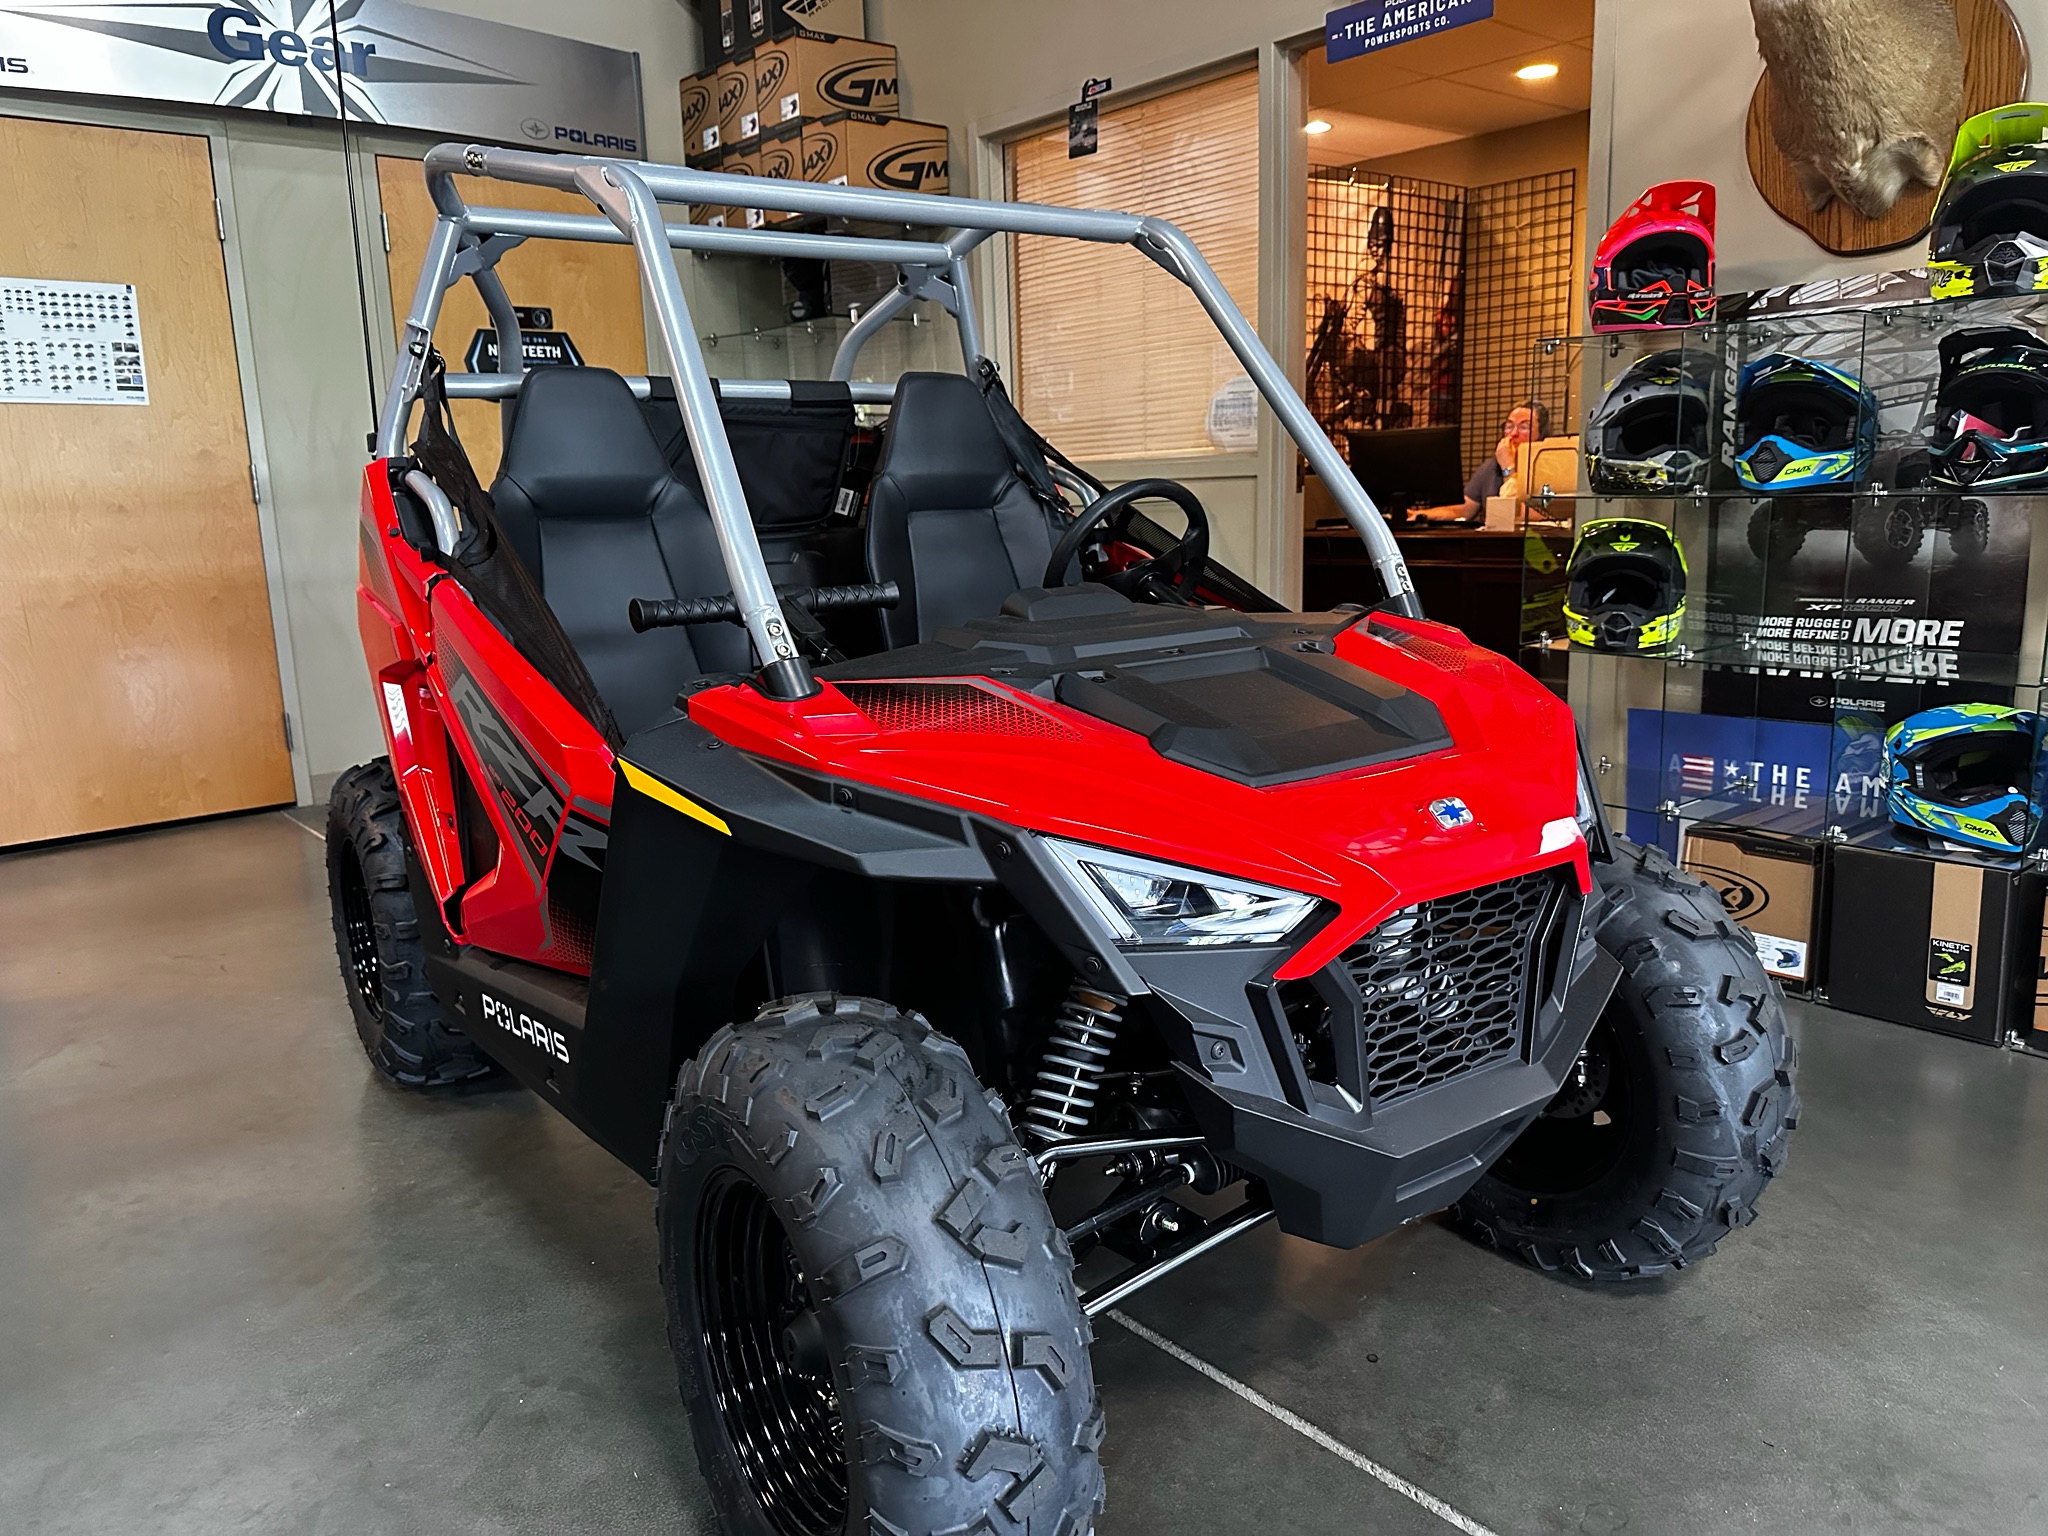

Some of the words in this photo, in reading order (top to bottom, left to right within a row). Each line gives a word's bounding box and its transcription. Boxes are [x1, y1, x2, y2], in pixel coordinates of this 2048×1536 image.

[1344, 17, 1376, 40] THE
[1382, 0, 1471, 29] AMERICA
[1364, 21, 1431, 48] POWERSPORTS
[1434, 16, 1450, 28] CO.
[207, 7, 376, 76] Gear
[799, 30, 826, 41] GMAX
[824, 64, 898, 107] GM
[850, 112, 877, 123] GMAX
[554, 126, 637, 152] POLARIS
[874, 145, 948, 191] GM
[521, 345, 561, 358] TEETH
[1855, 598, 1916, 606] RANGER
[1756, 628, 1791, 638] MORE
[1793, 628, 1849, 640] REFINED
[1759, 617, 1794, 628] MORE
[1795, 617, 1852, 629] RUGGED
[1852, 617, 1965, 647] MORE
[1830, 697, 1886, 708] POLARIS
[1747, 761, 1811, 789] THE
[1834, 772, 1880, 798] AM
[500, 789, 549, 857] 200
[1963, 823, 1998, 837] GMAX
[1932, 940, 1970, 952] KINETIC
[481, 993, 570, 1064] POLARIS
